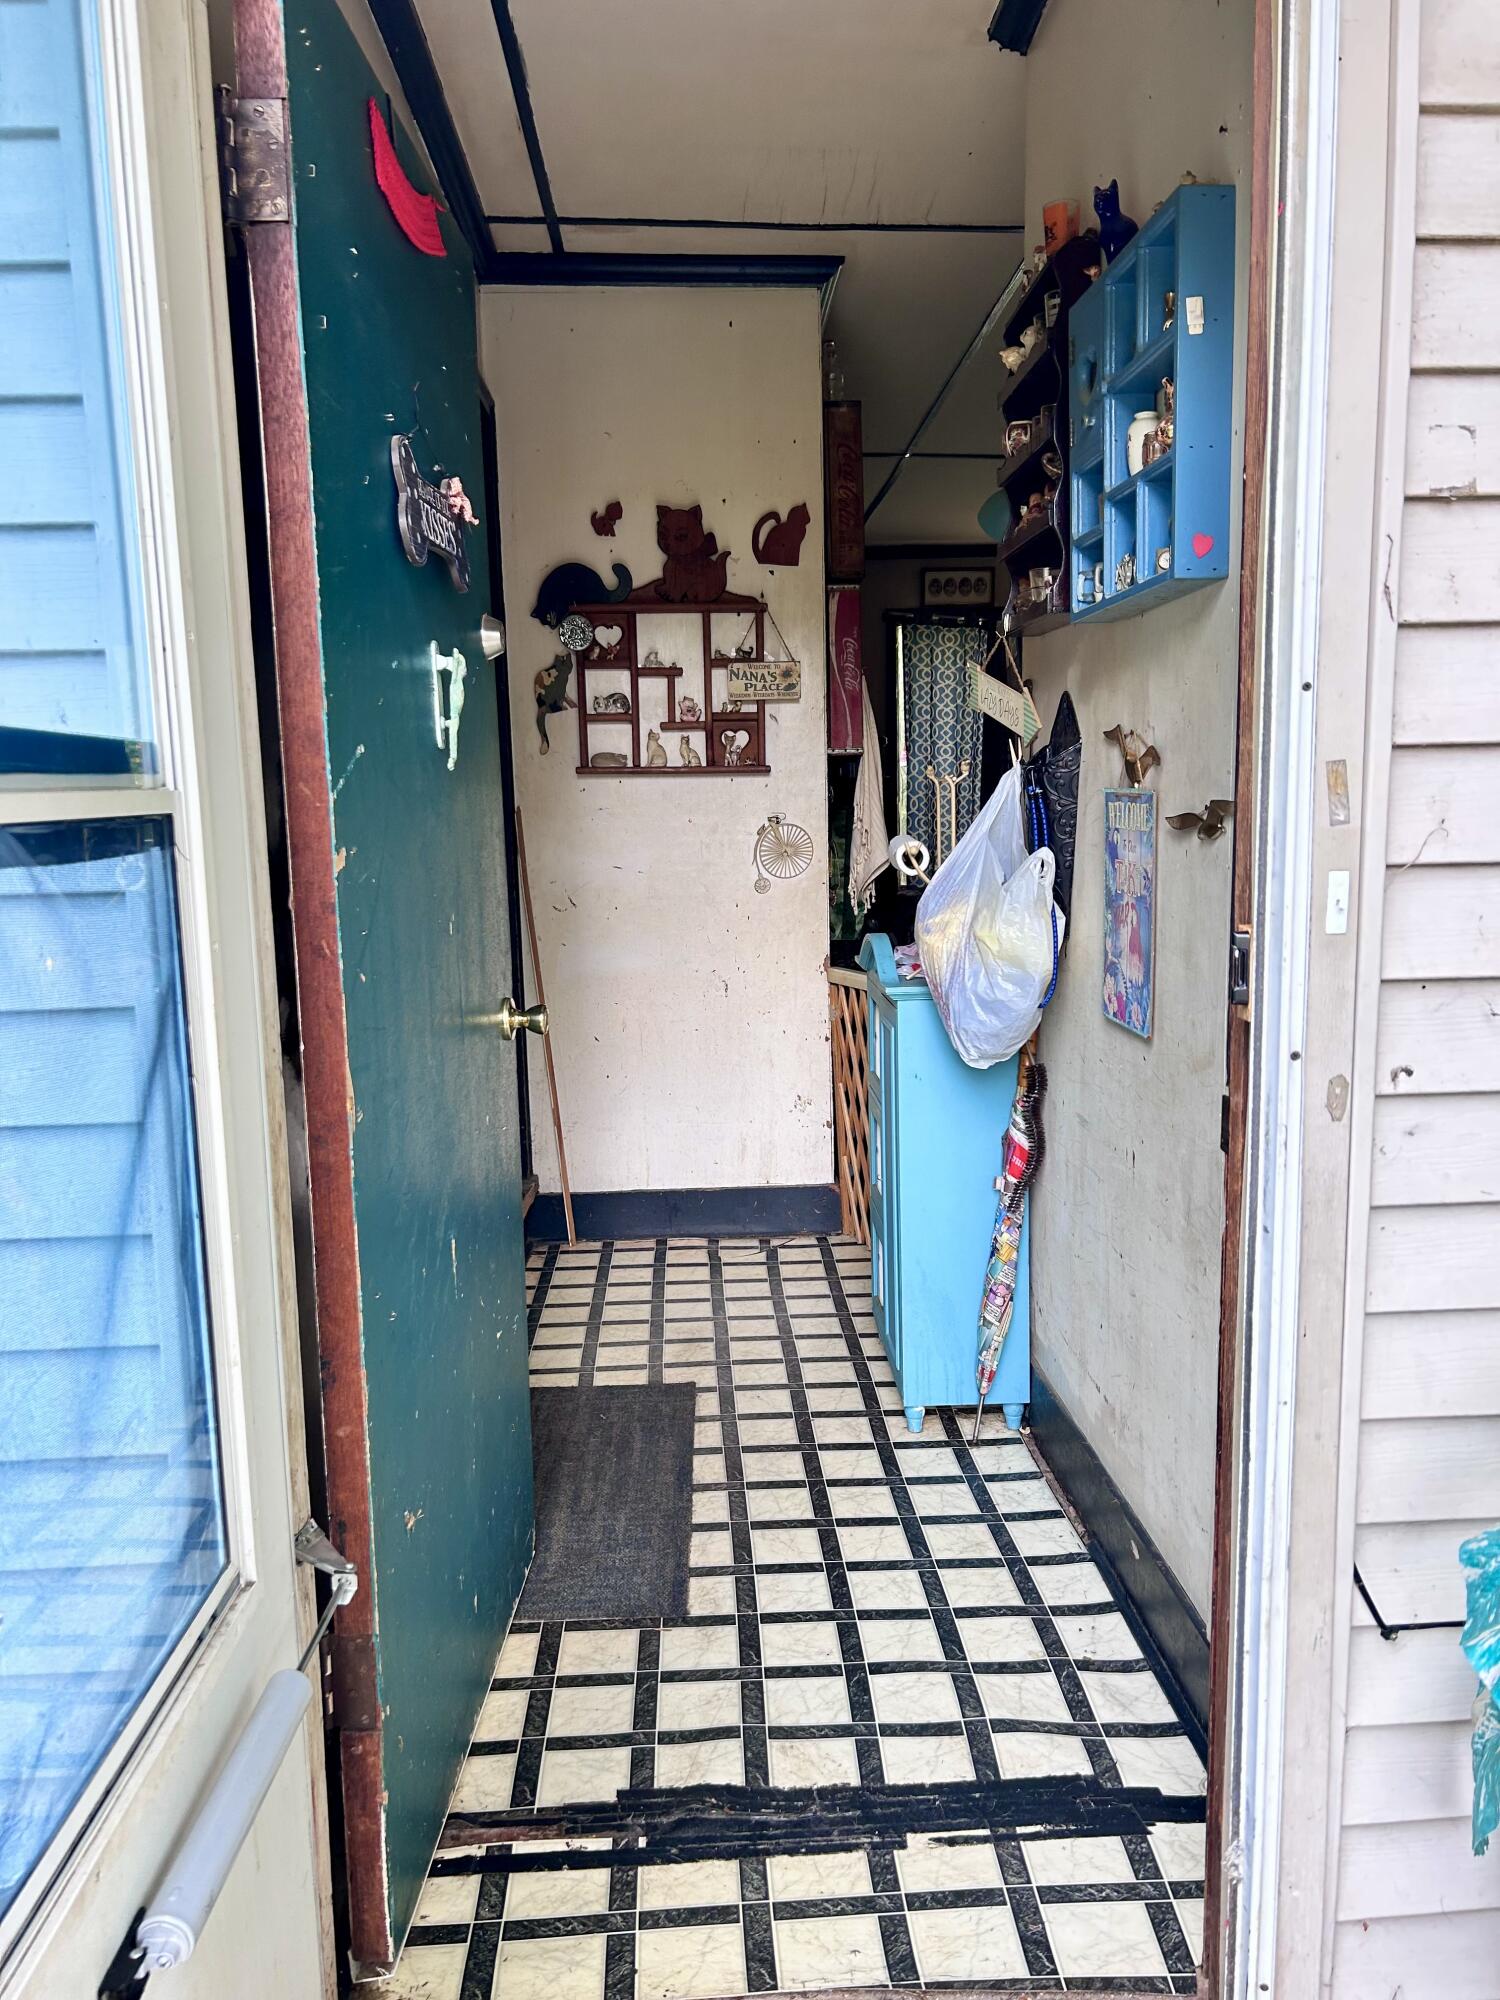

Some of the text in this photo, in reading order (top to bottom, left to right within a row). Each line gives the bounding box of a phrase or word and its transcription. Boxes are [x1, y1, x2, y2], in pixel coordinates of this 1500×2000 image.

[419, 499, 457, 556] KISSES
[729, 668, 777, 683] NANA'S
[744, 683, 783, 692] PLACE
[1108, 801, 1150, 832] WELCOME
